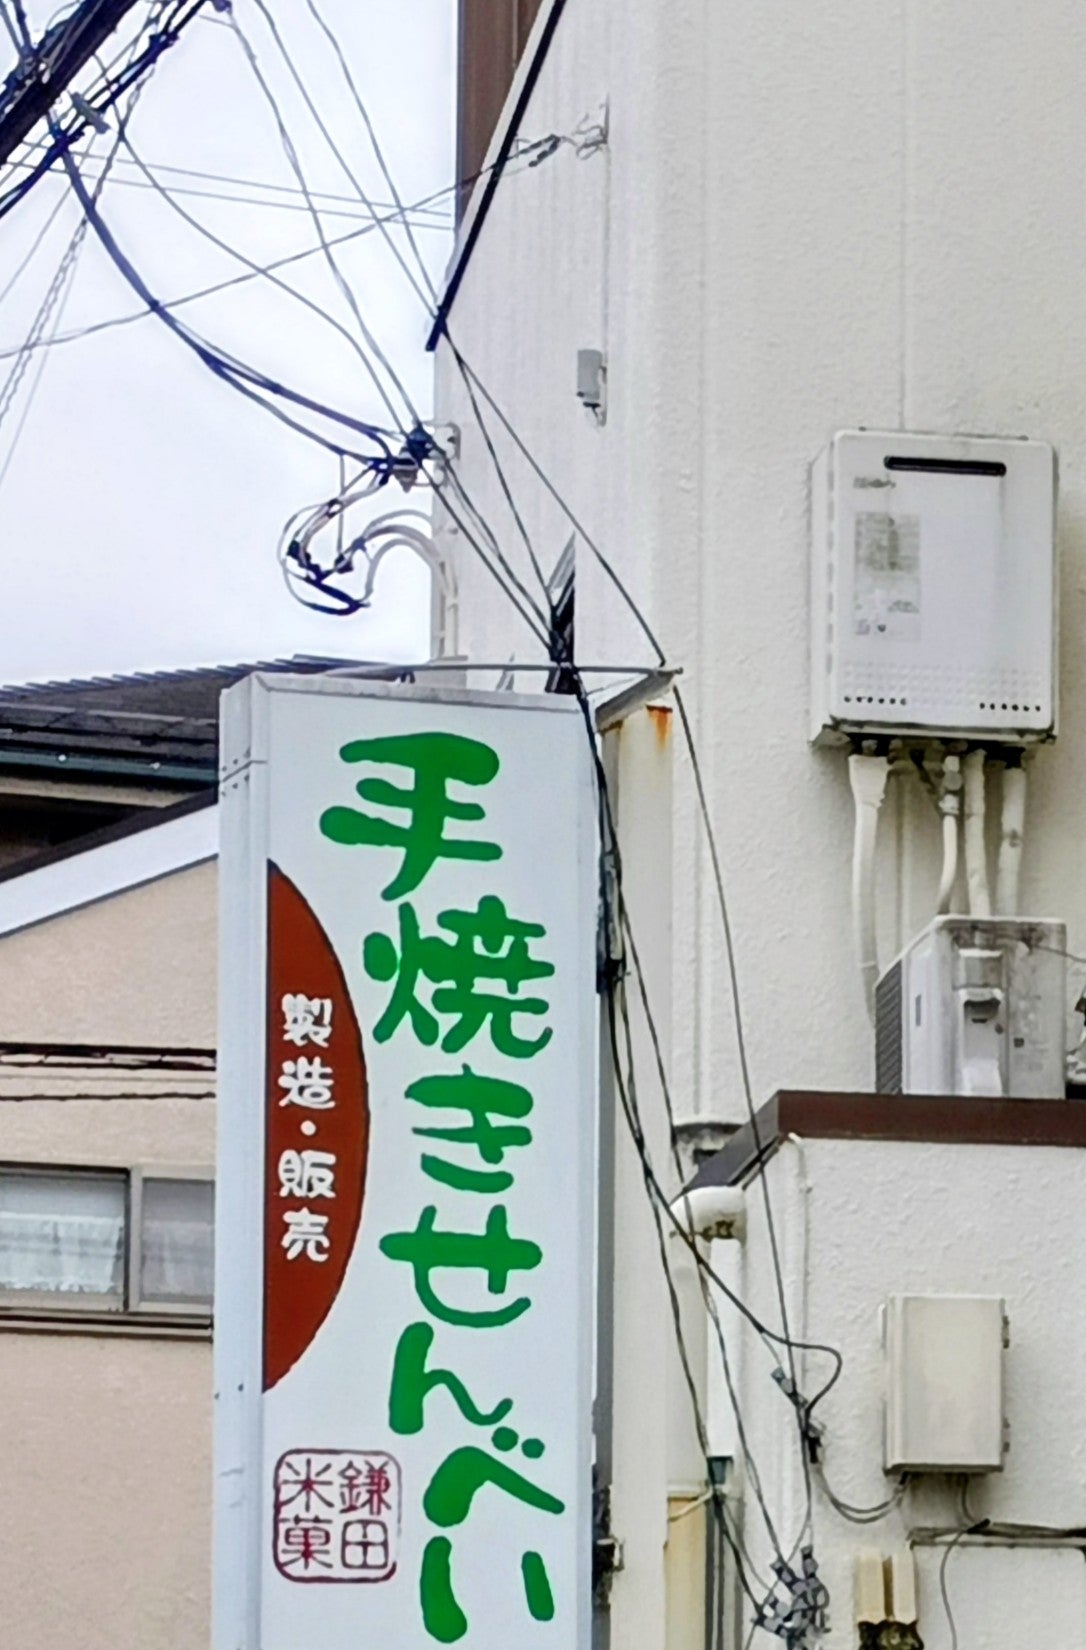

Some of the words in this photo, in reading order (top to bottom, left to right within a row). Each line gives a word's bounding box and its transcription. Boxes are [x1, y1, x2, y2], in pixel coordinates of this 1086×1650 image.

[277, 993, 336, 1262] 製造・販売
[319, 731, 565, 1643] 手焼きせんべい
